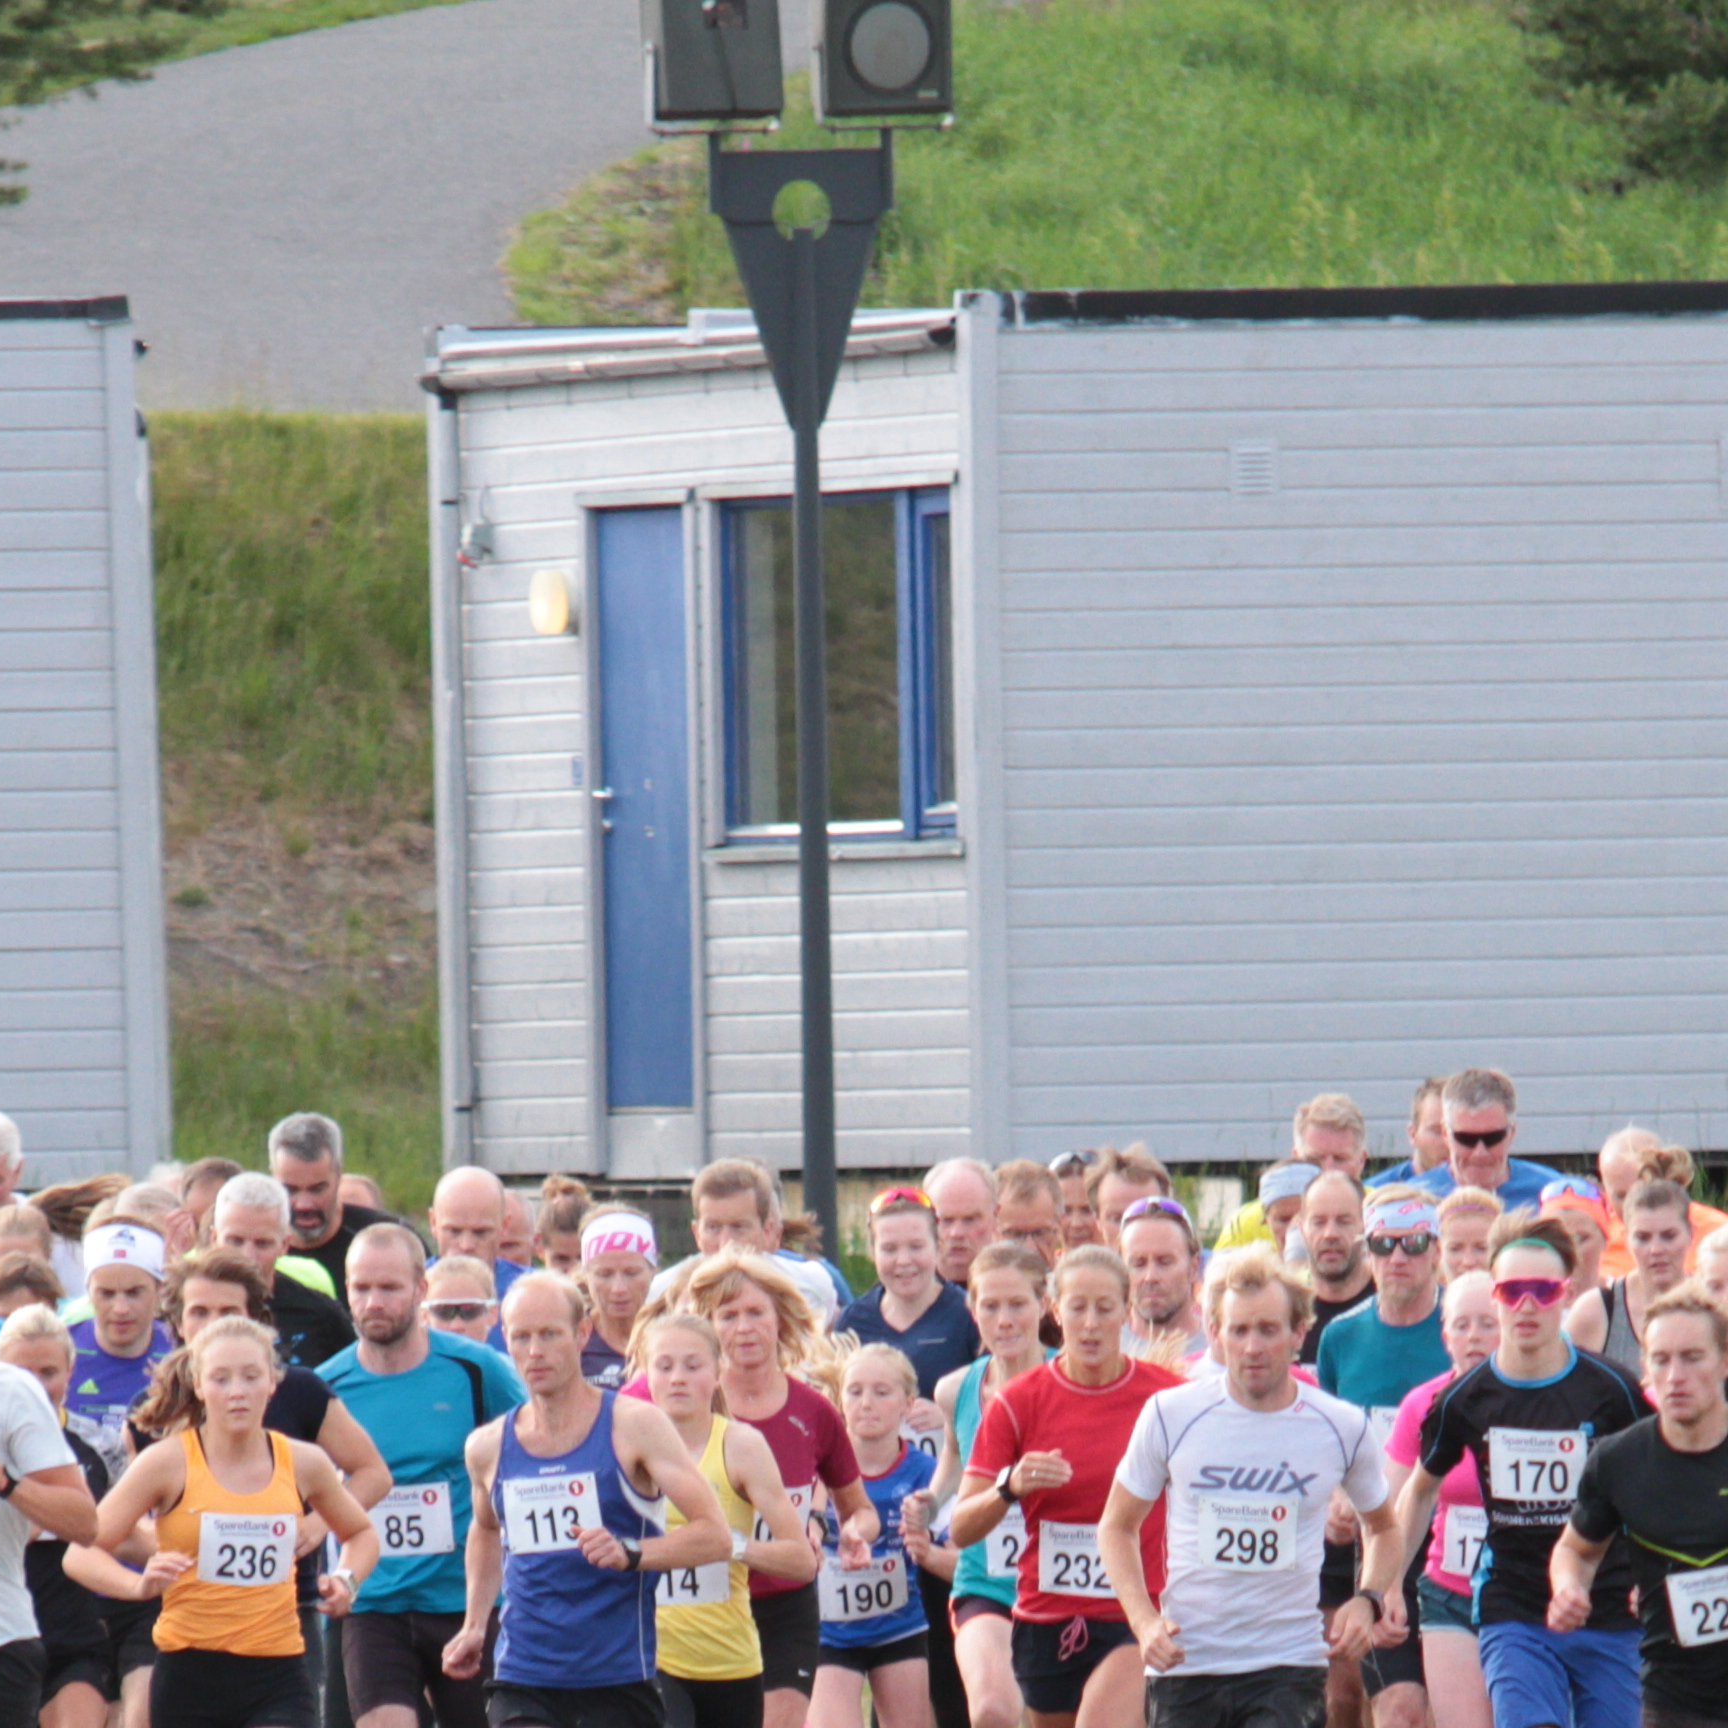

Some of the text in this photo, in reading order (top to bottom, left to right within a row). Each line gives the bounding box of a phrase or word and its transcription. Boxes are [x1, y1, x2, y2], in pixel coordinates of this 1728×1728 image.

[1508, 1459, 1570, 1494] 170
[385, 1515, 425, 1549] 85
[525, 1506, 580, 1544] 113
[215, 1543, 278, 1579] 236
[1215, 1527, 1279, 1565] 298
[1053, 1552, 1112, 1589] 232
[837, 1580, 894, 1614] 190
